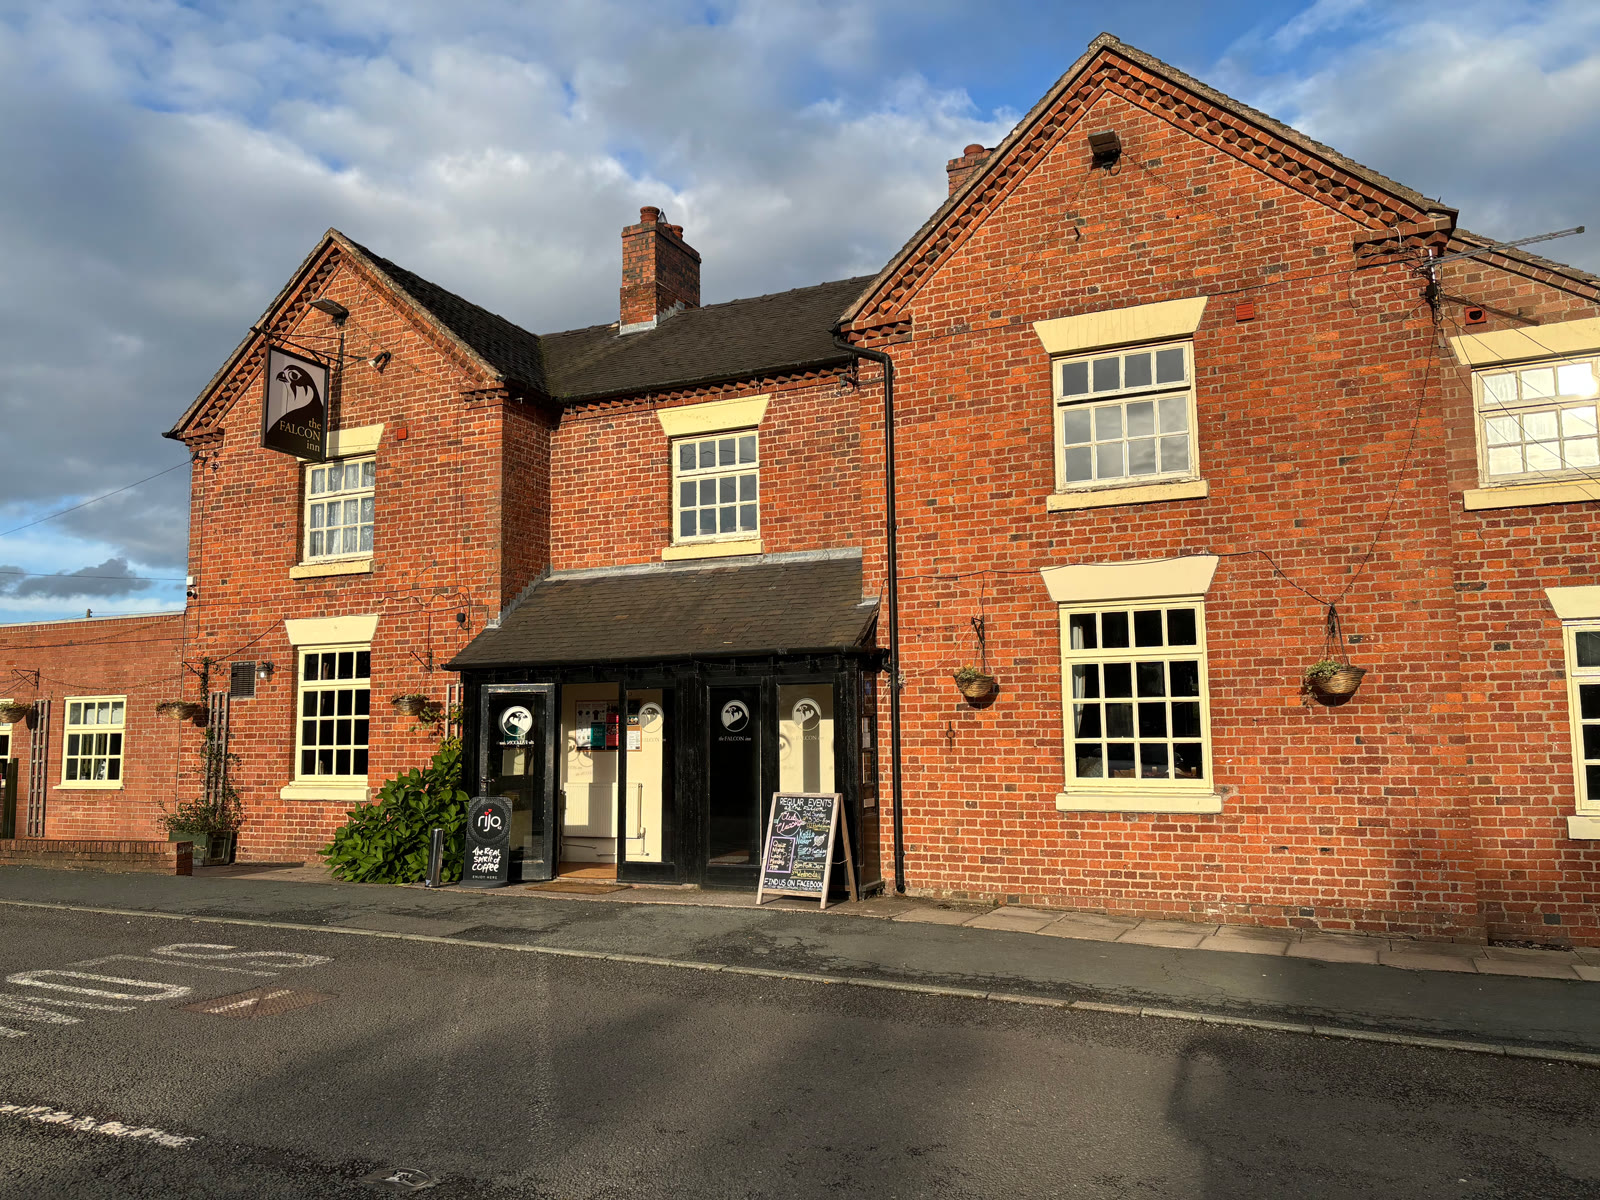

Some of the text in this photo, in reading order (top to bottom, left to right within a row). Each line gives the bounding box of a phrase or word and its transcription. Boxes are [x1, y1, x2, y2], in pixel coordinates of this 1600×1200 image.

[308, 417, 321, 430] the
[279, 420, 321, 441] FALCON
[306, 440, 320, 452] inn
[780, 797, 832, 808] REGULAR EVENTS
[477, 809, 501, 832] rijo
[772, 839, 787, 848] Quiz
[772, 846, 785, 855] Night
[493, 855, 502, 865] of
[764, 877, 778, 886] FIND
[779, 879, 787, 887] US
[787, 879, 796, 887] ON
[797, 880, 824, 889] FACEBOOK
